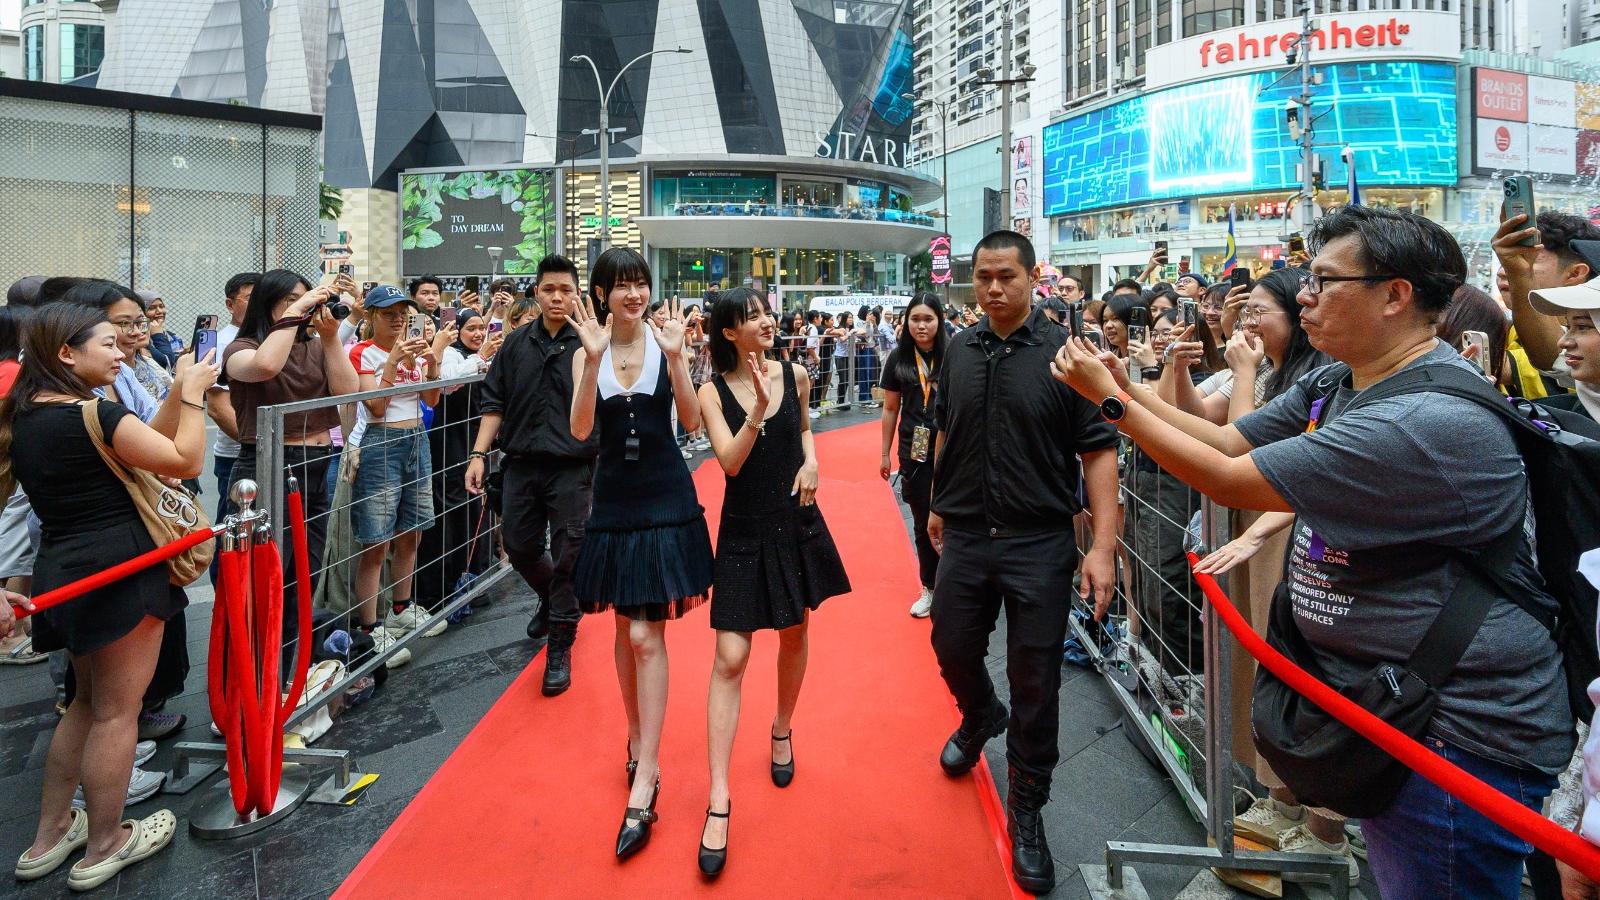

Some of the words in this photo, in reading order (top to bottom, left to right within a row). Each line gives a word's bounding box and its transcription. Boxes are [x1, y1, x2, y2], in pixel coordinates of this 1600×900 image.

[1199, 18, 1402, 67] fahrenheit
[1481, 78, 1523, 97] BRANDS
[1482, 94, 1522, 111] OUTLET
[450, 215, 465, 224] TO
[451, 224, 469, 233] DAY
[470, 223, 504, 233] DREAM
[825, 298, 845, 307] BALAI
[845, 297, 865, 306] POLIS
[866, 297, 903, 306] BERGERAK
[1296, 595, 1310, 608] THE
[1310, 600, 1350, 616] STILLEST
[1327, 592, 1355, 606] ONLY
[1297, 607, 1334, 626] SURFACES
